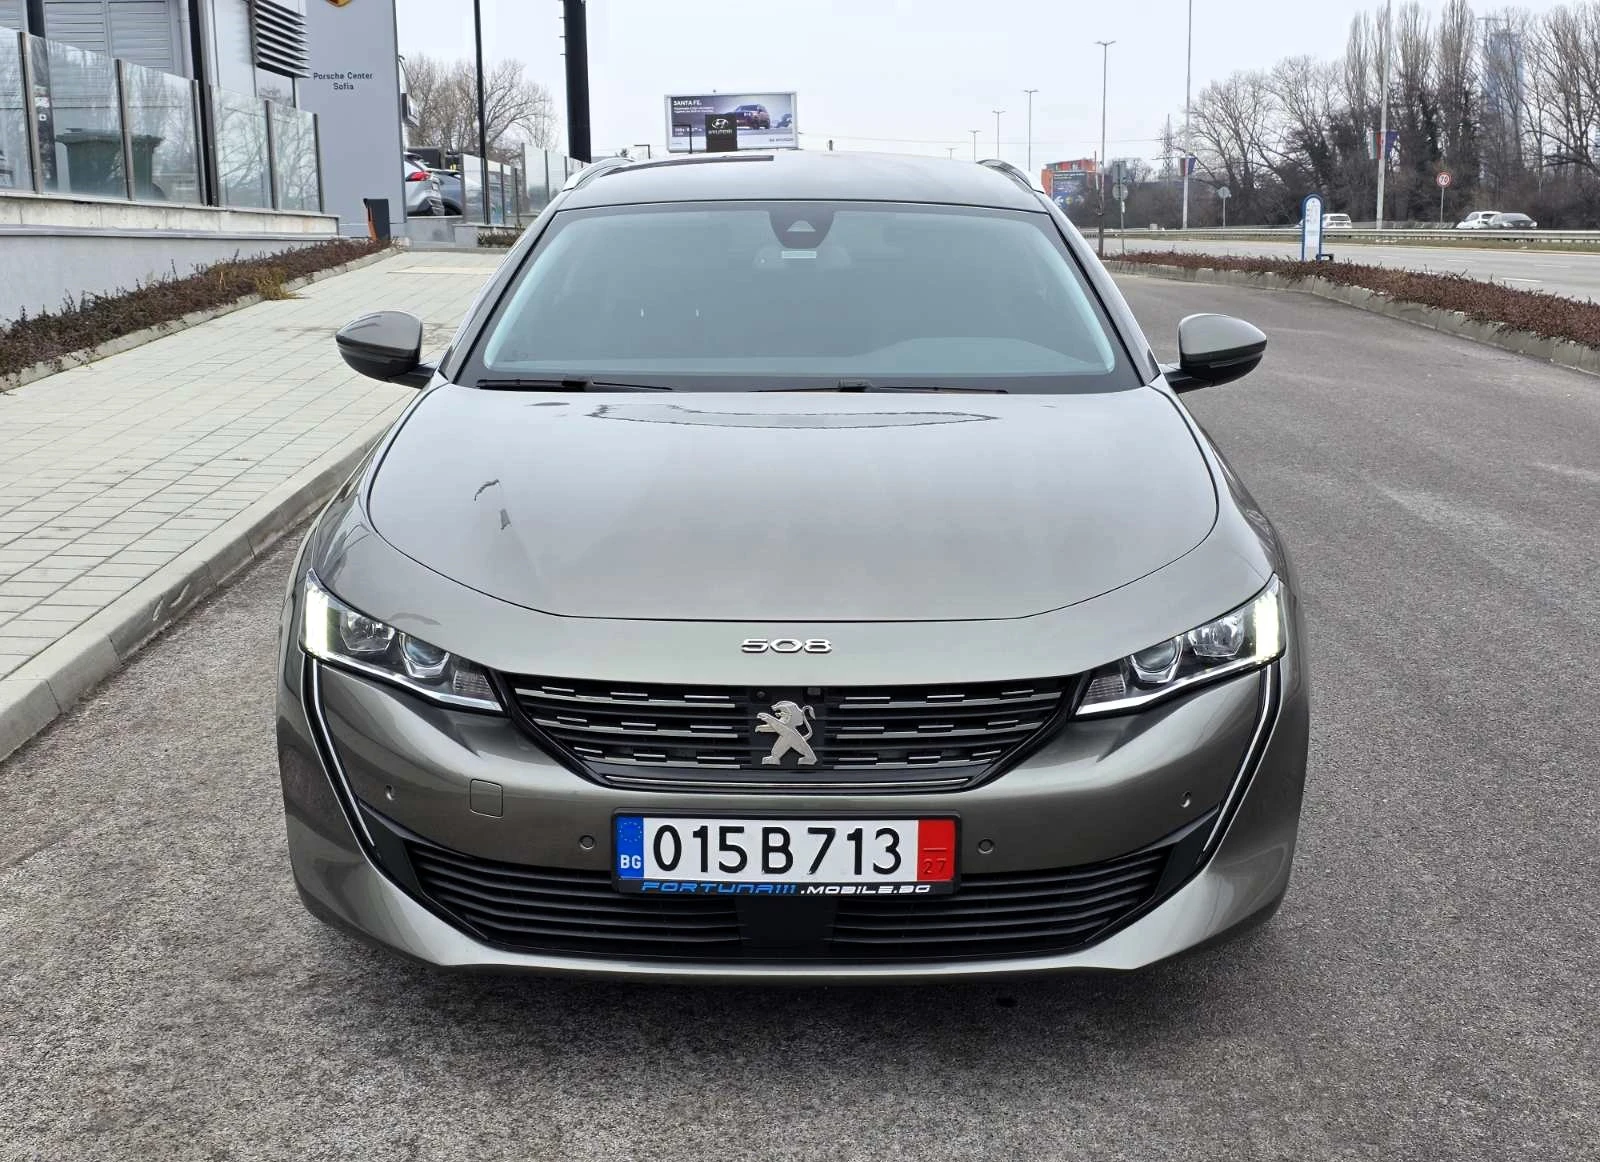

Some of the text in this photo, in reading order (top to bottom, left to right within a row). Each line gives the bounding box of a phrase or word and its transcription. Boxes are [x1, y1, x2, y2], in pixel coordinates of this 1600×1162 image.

[313, 71, 373, 80] Porsche Center
[333, 82, 354, 90] Sofia
[741, 638, 832, 654] 508
[620, 854, 642, 869] BG
[922, 857, 948, 874] 27
